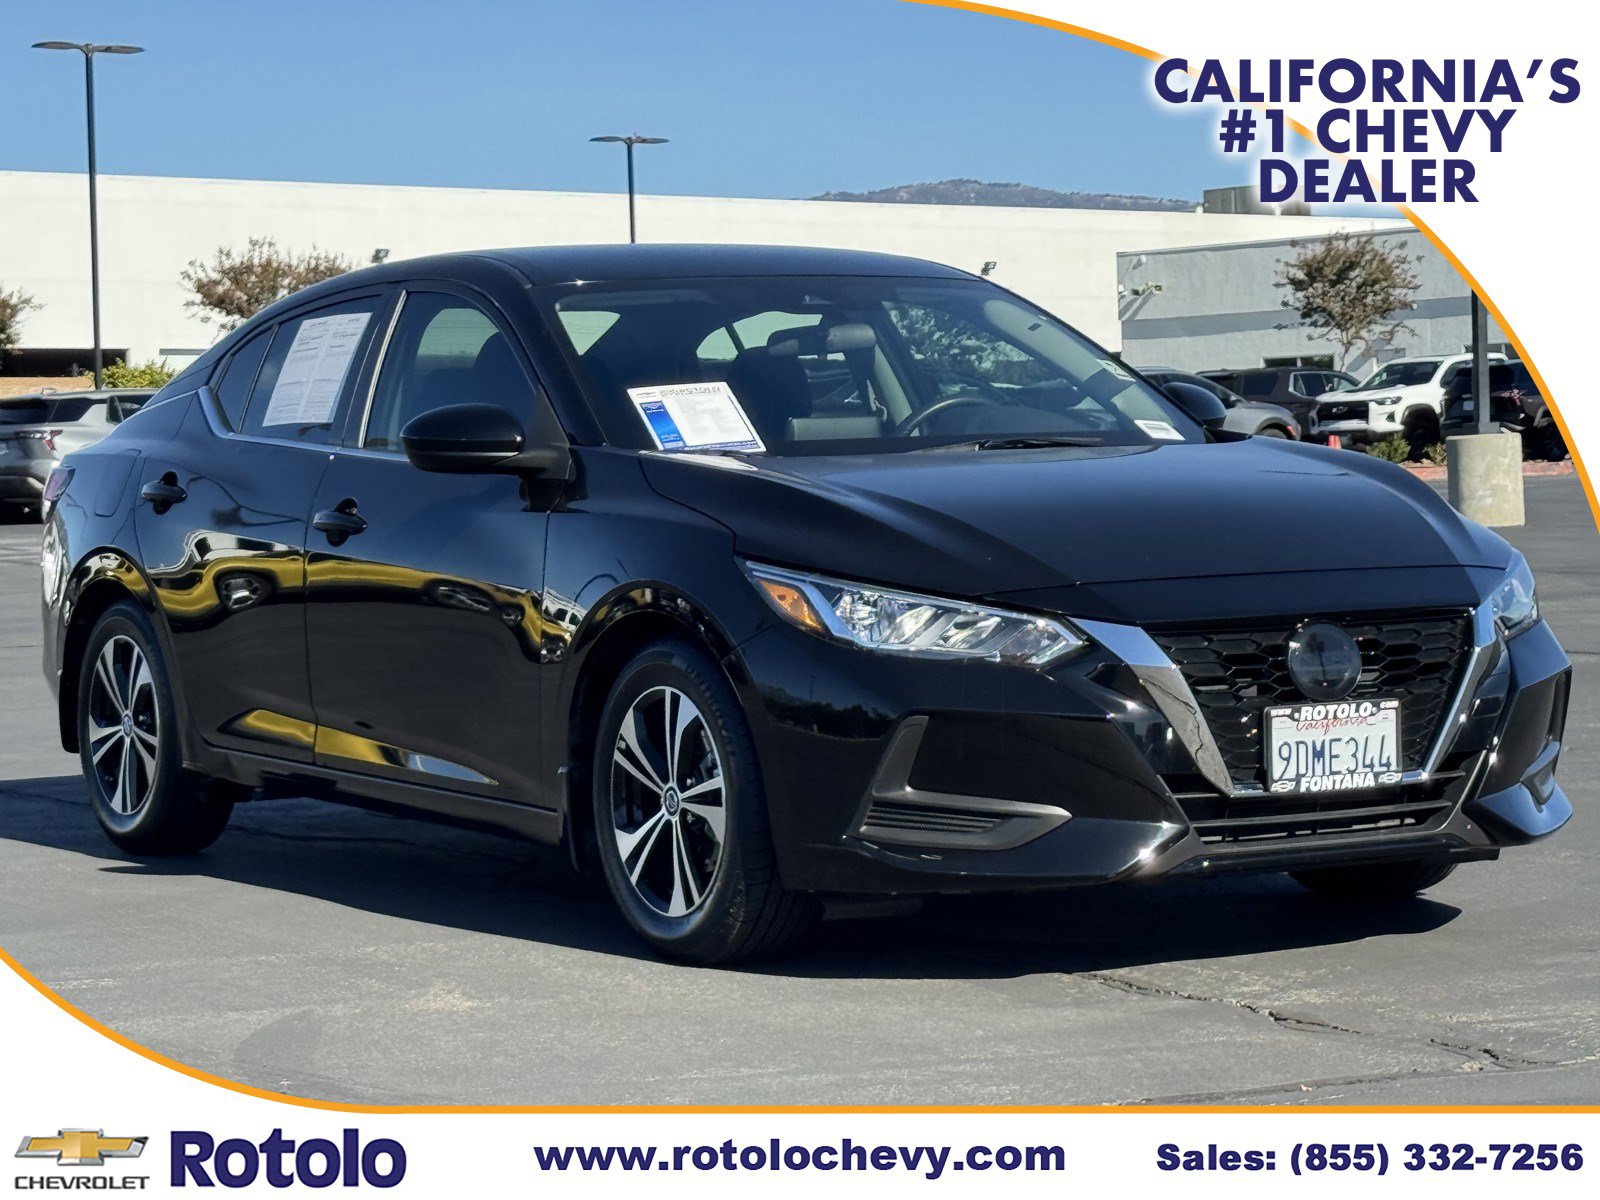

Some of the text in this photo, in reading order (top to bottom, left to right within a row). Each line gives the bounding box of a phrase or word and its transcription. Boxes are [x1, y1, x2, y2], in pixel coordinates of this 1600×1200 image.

[1299, 702, 1373, 721] ROTOLO
[1277, 734, 1393, 781] 9DME344
[1299, 772, 1376, 793] FONTANA
